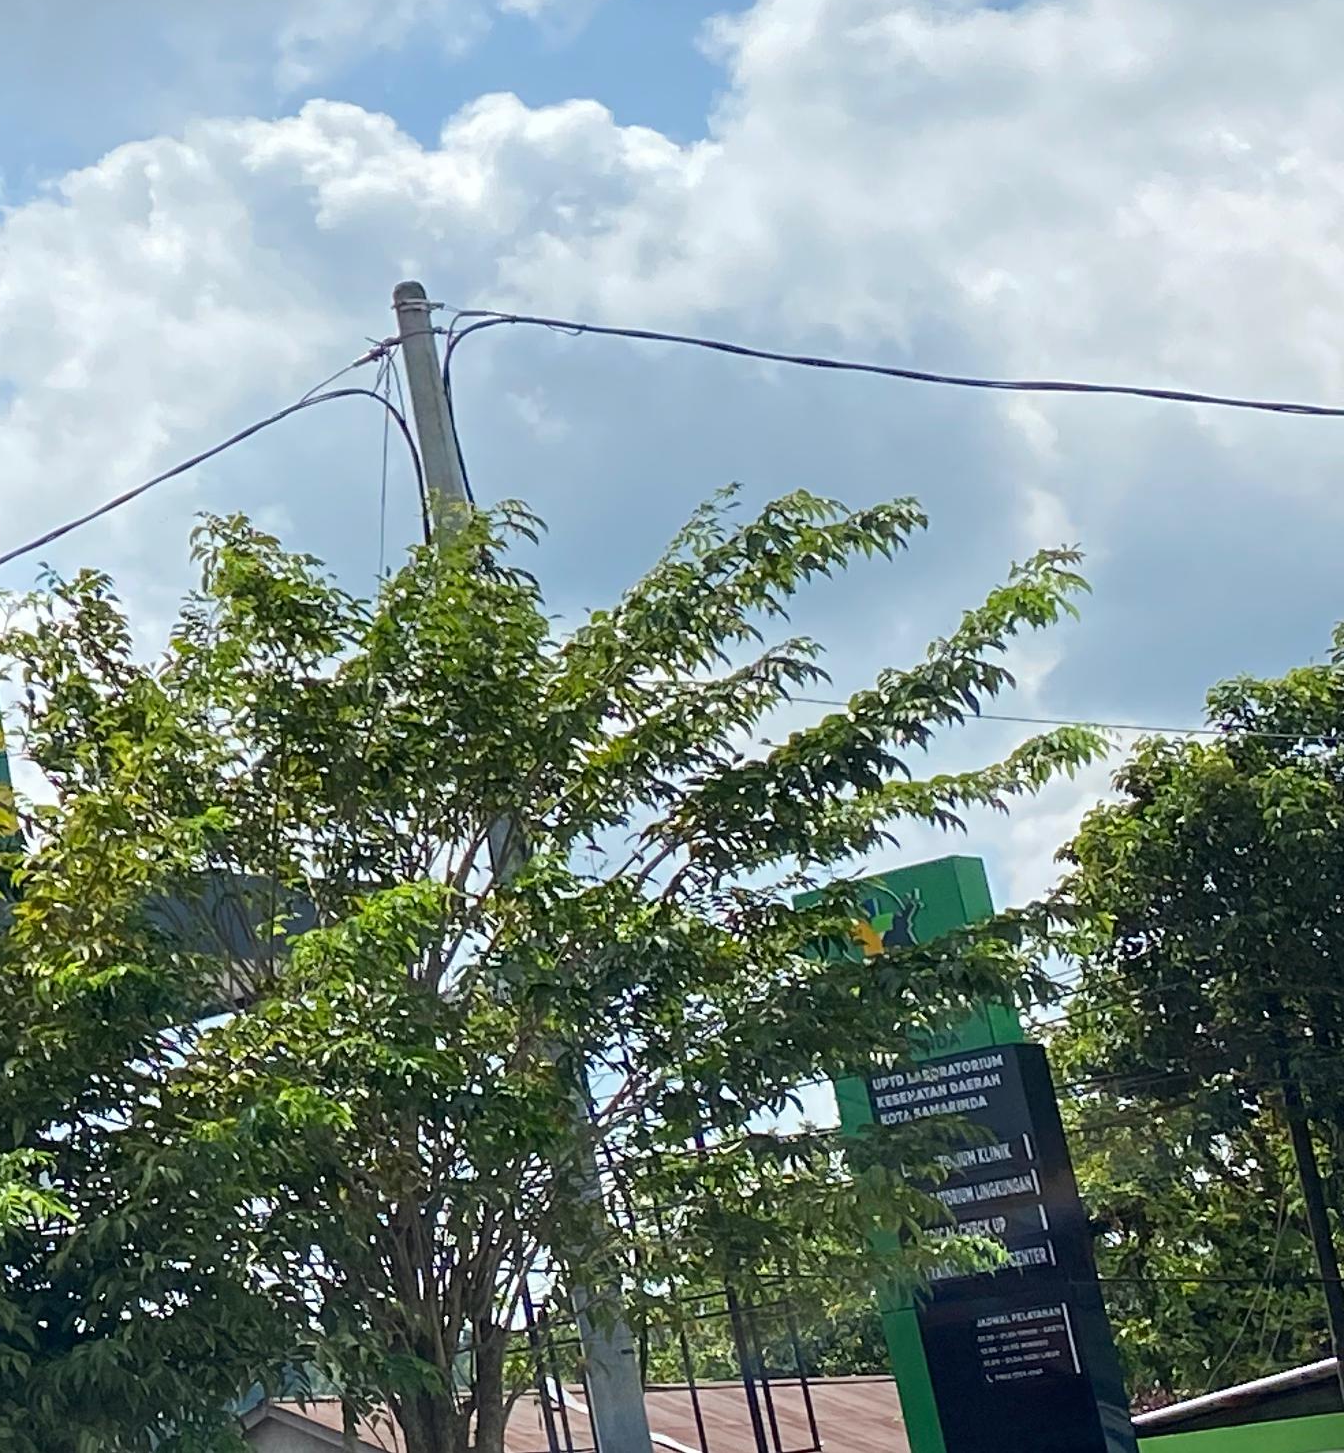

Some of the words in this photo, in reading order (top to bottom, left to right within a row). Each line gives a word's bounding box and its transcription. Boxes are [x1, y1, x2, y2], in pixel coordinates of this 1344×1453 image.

[872, 1074, 905, 1090] UPTD
[949, 1074, 1002, 1094] DAERAH
[880, 1111, 912, 1126] KOTA
[978, 1143, 1012, 1163] KLINIK
